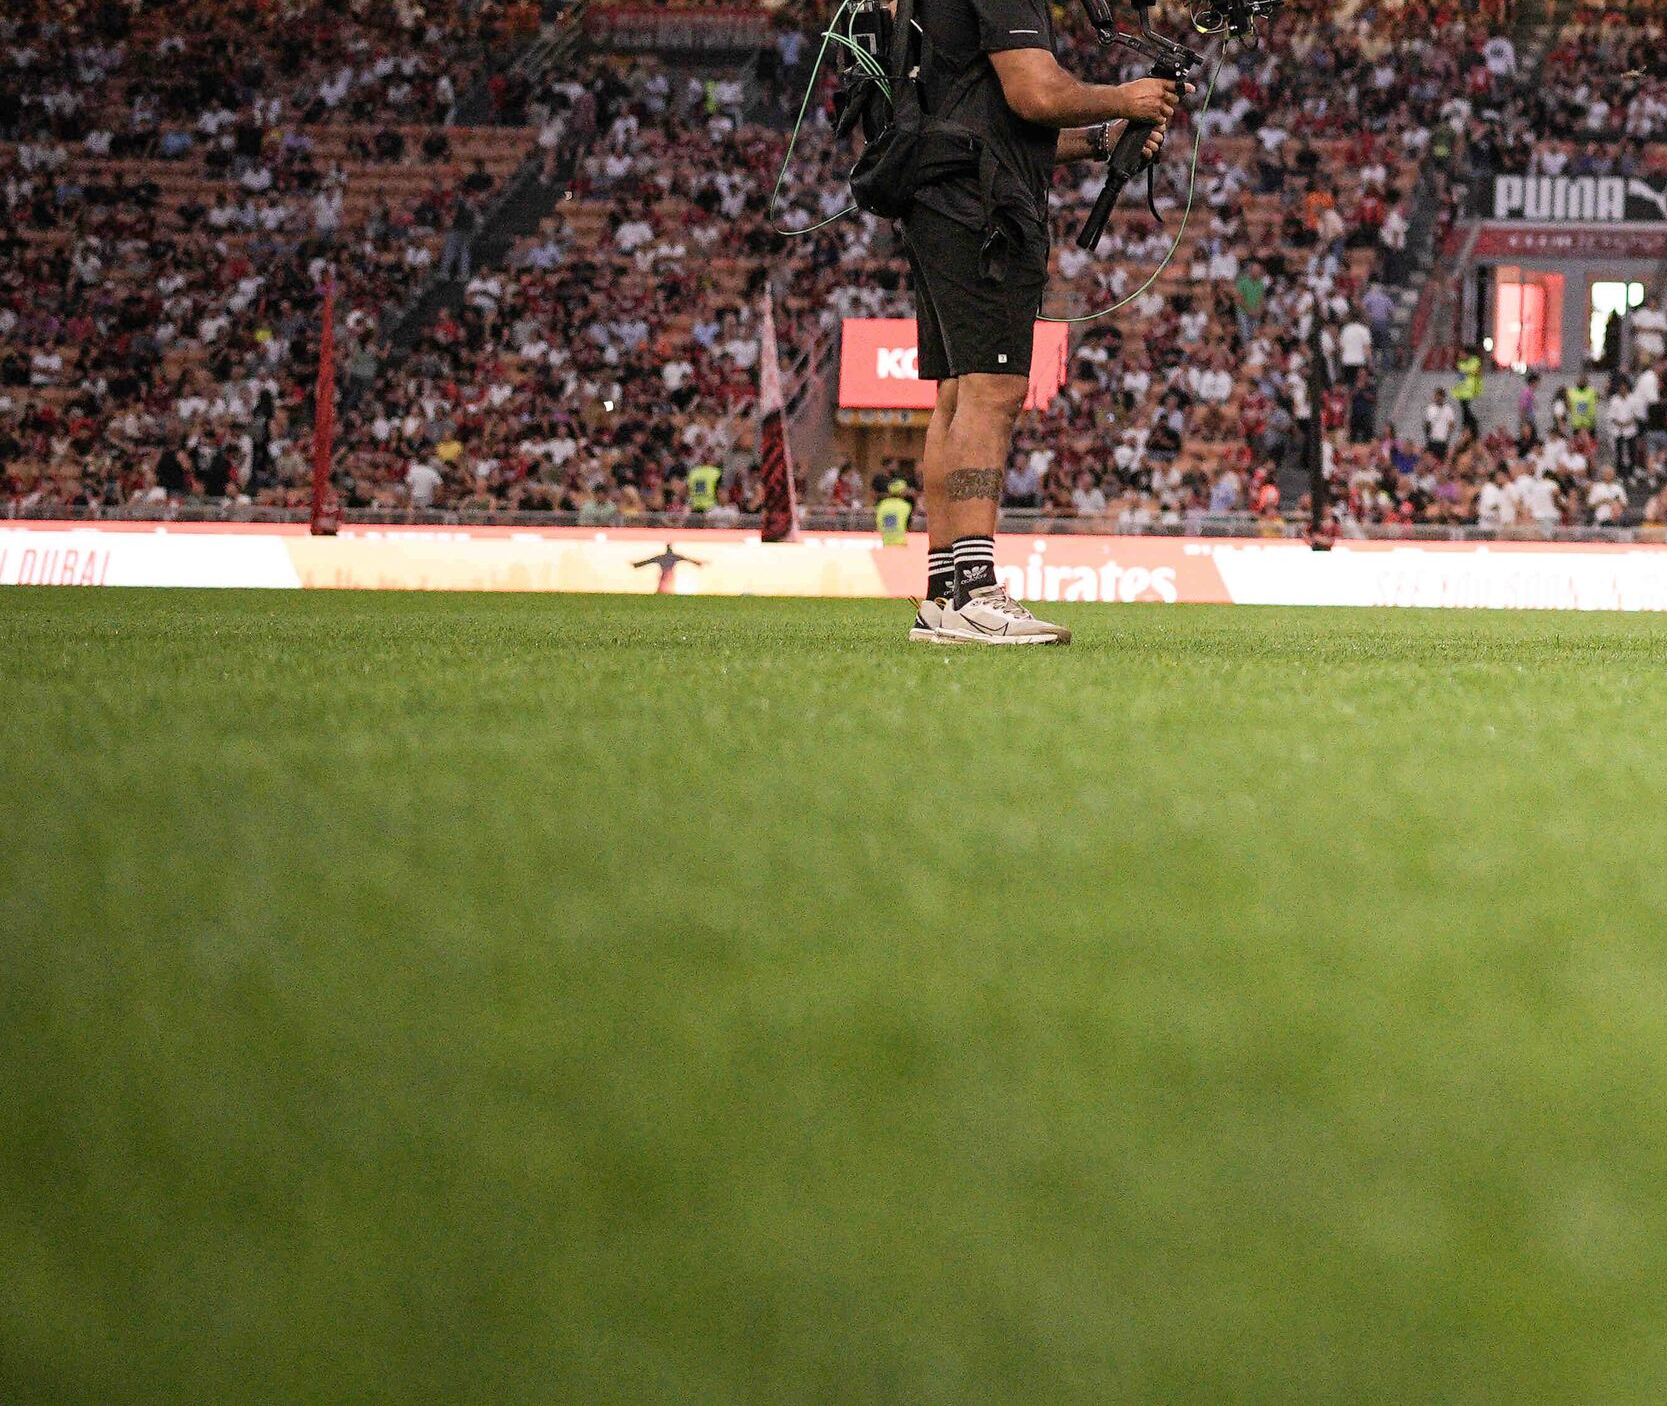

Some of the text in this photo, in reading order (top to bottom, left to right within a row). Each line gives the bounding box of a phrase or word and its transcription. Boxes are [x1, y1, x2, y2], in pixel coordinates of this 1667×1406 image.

[1494, 174, 1627, 220] PUMA
[17, 546, 112, 585] DUBAI
[996, 554, 1177, 603] irates
